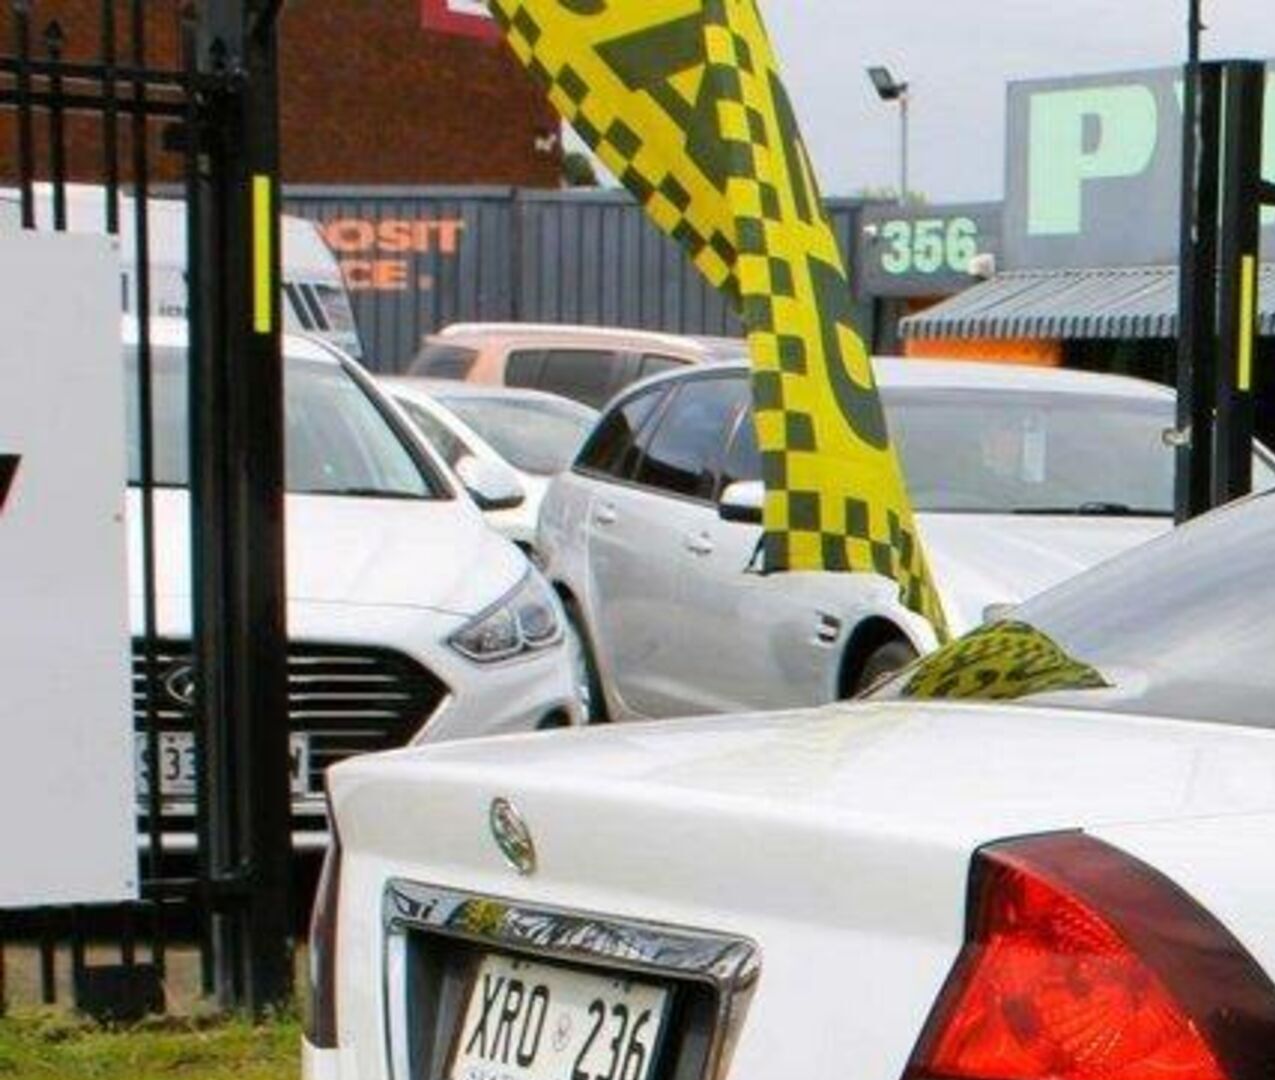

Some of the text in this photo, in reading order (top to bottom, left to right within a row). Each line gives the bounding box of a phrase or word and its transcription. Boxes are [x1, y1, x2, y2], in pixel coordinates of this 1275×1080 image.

[322, 217, 464, 254] OSIT
[881, 218, 977, 273] 356
[466, 974, 550, 1067] XRO
